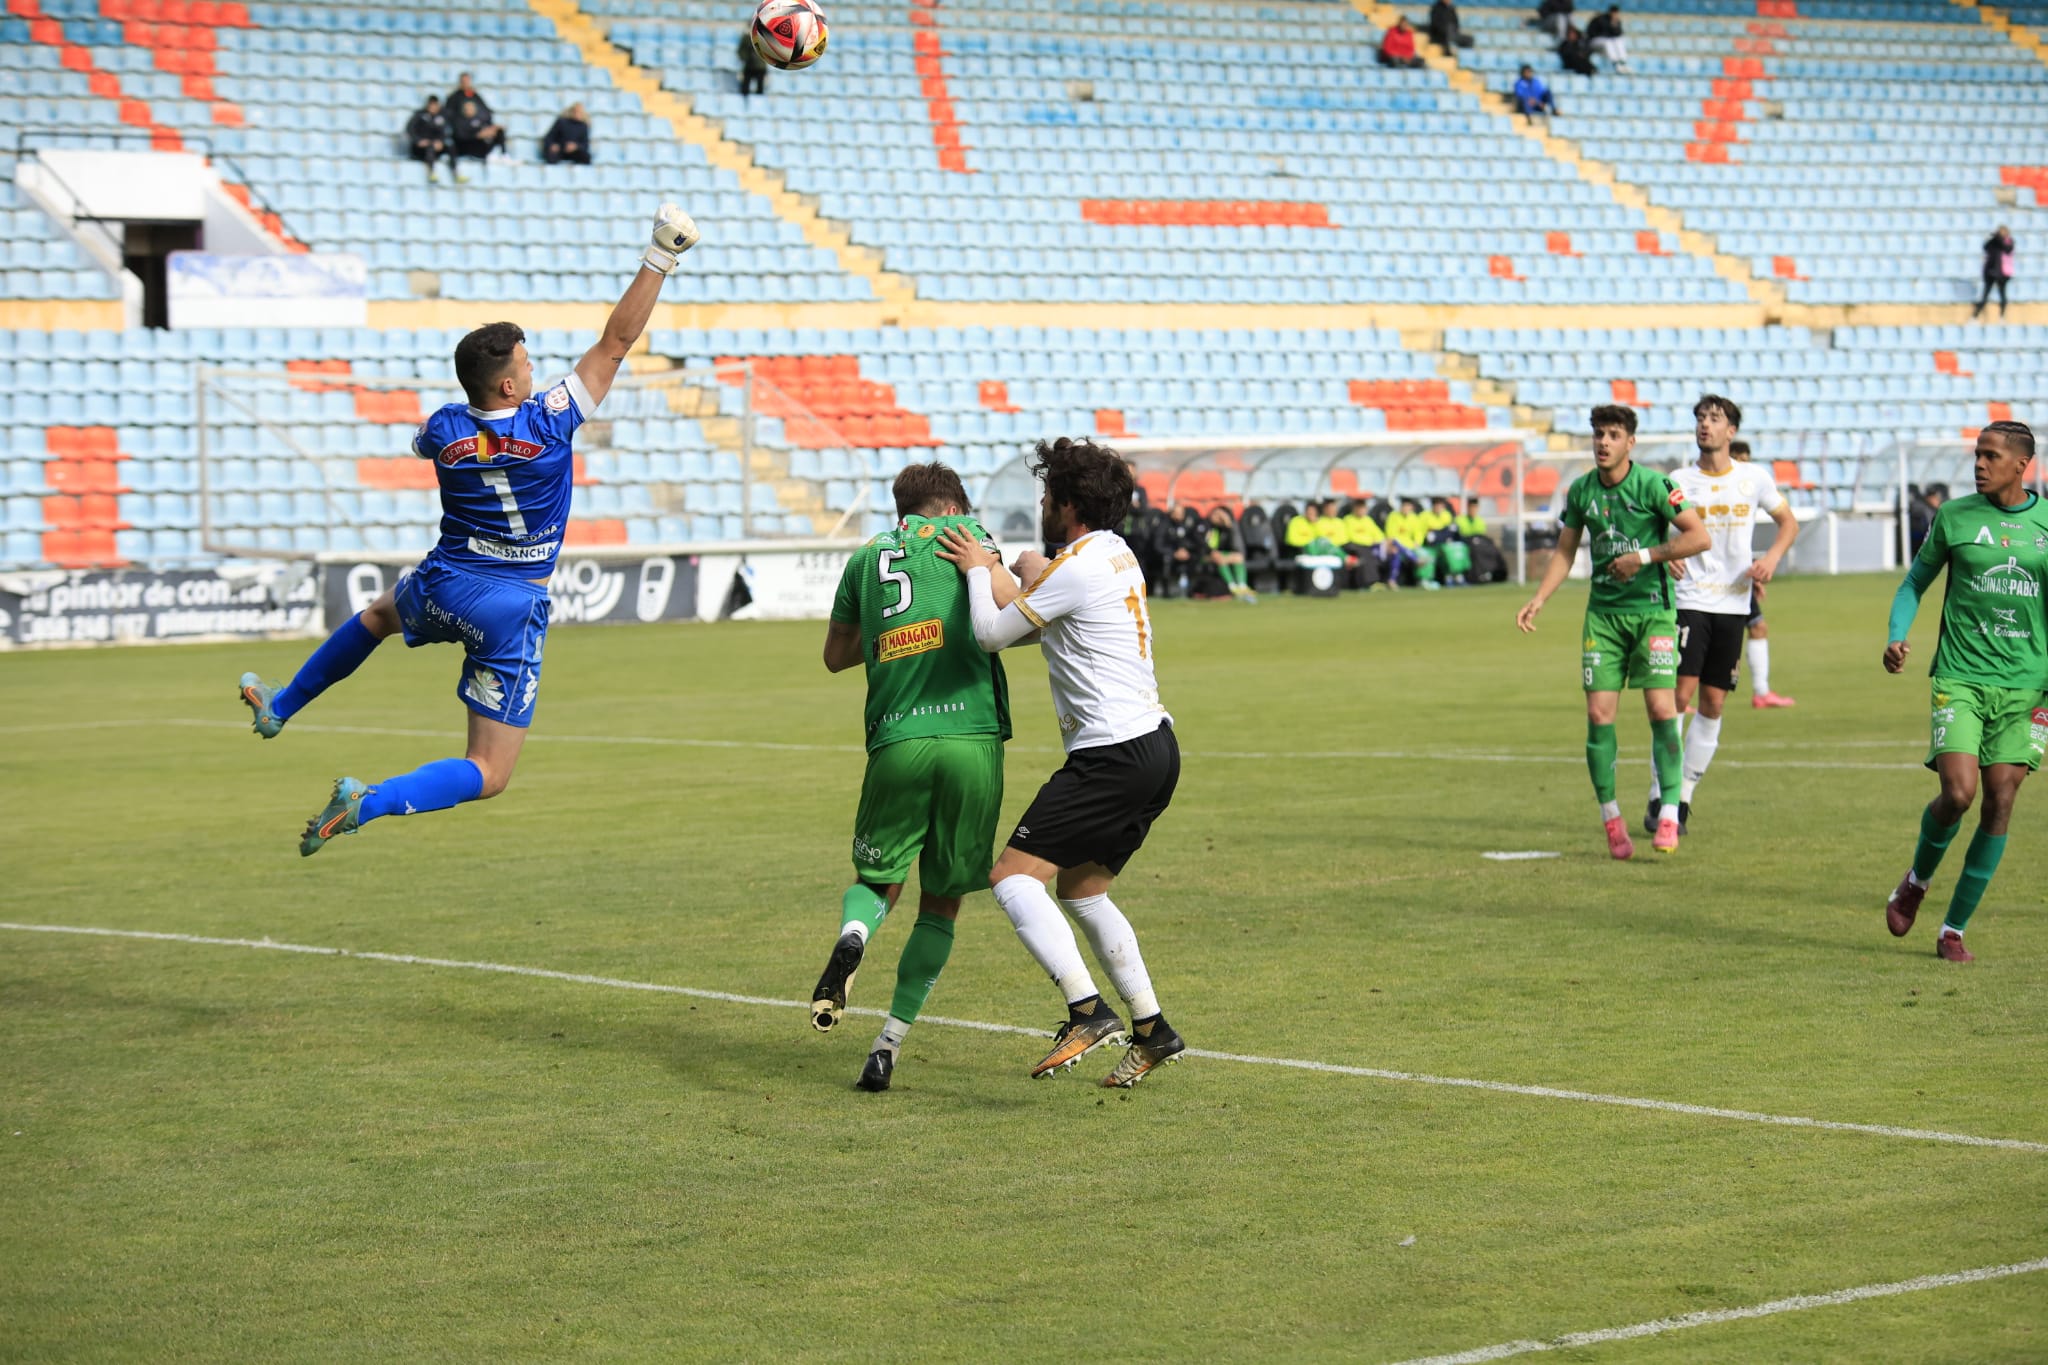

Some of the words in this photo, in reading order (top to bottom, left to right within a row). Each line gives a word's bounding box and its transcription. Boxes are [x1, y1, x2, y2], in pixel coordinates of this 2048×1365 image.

[443, 441, 476, 463] CECINAS
[504, 441, 531, 456] PABLO
[480, 469, 529, 535] 1
[51, 577, 145, 617] pintor
[145, 580, 176, 606] de
[878, 547, 913, 620] 5
[889, 623, 938, 650] MARAGATO
[1584, 667, 1594, 686] 9
